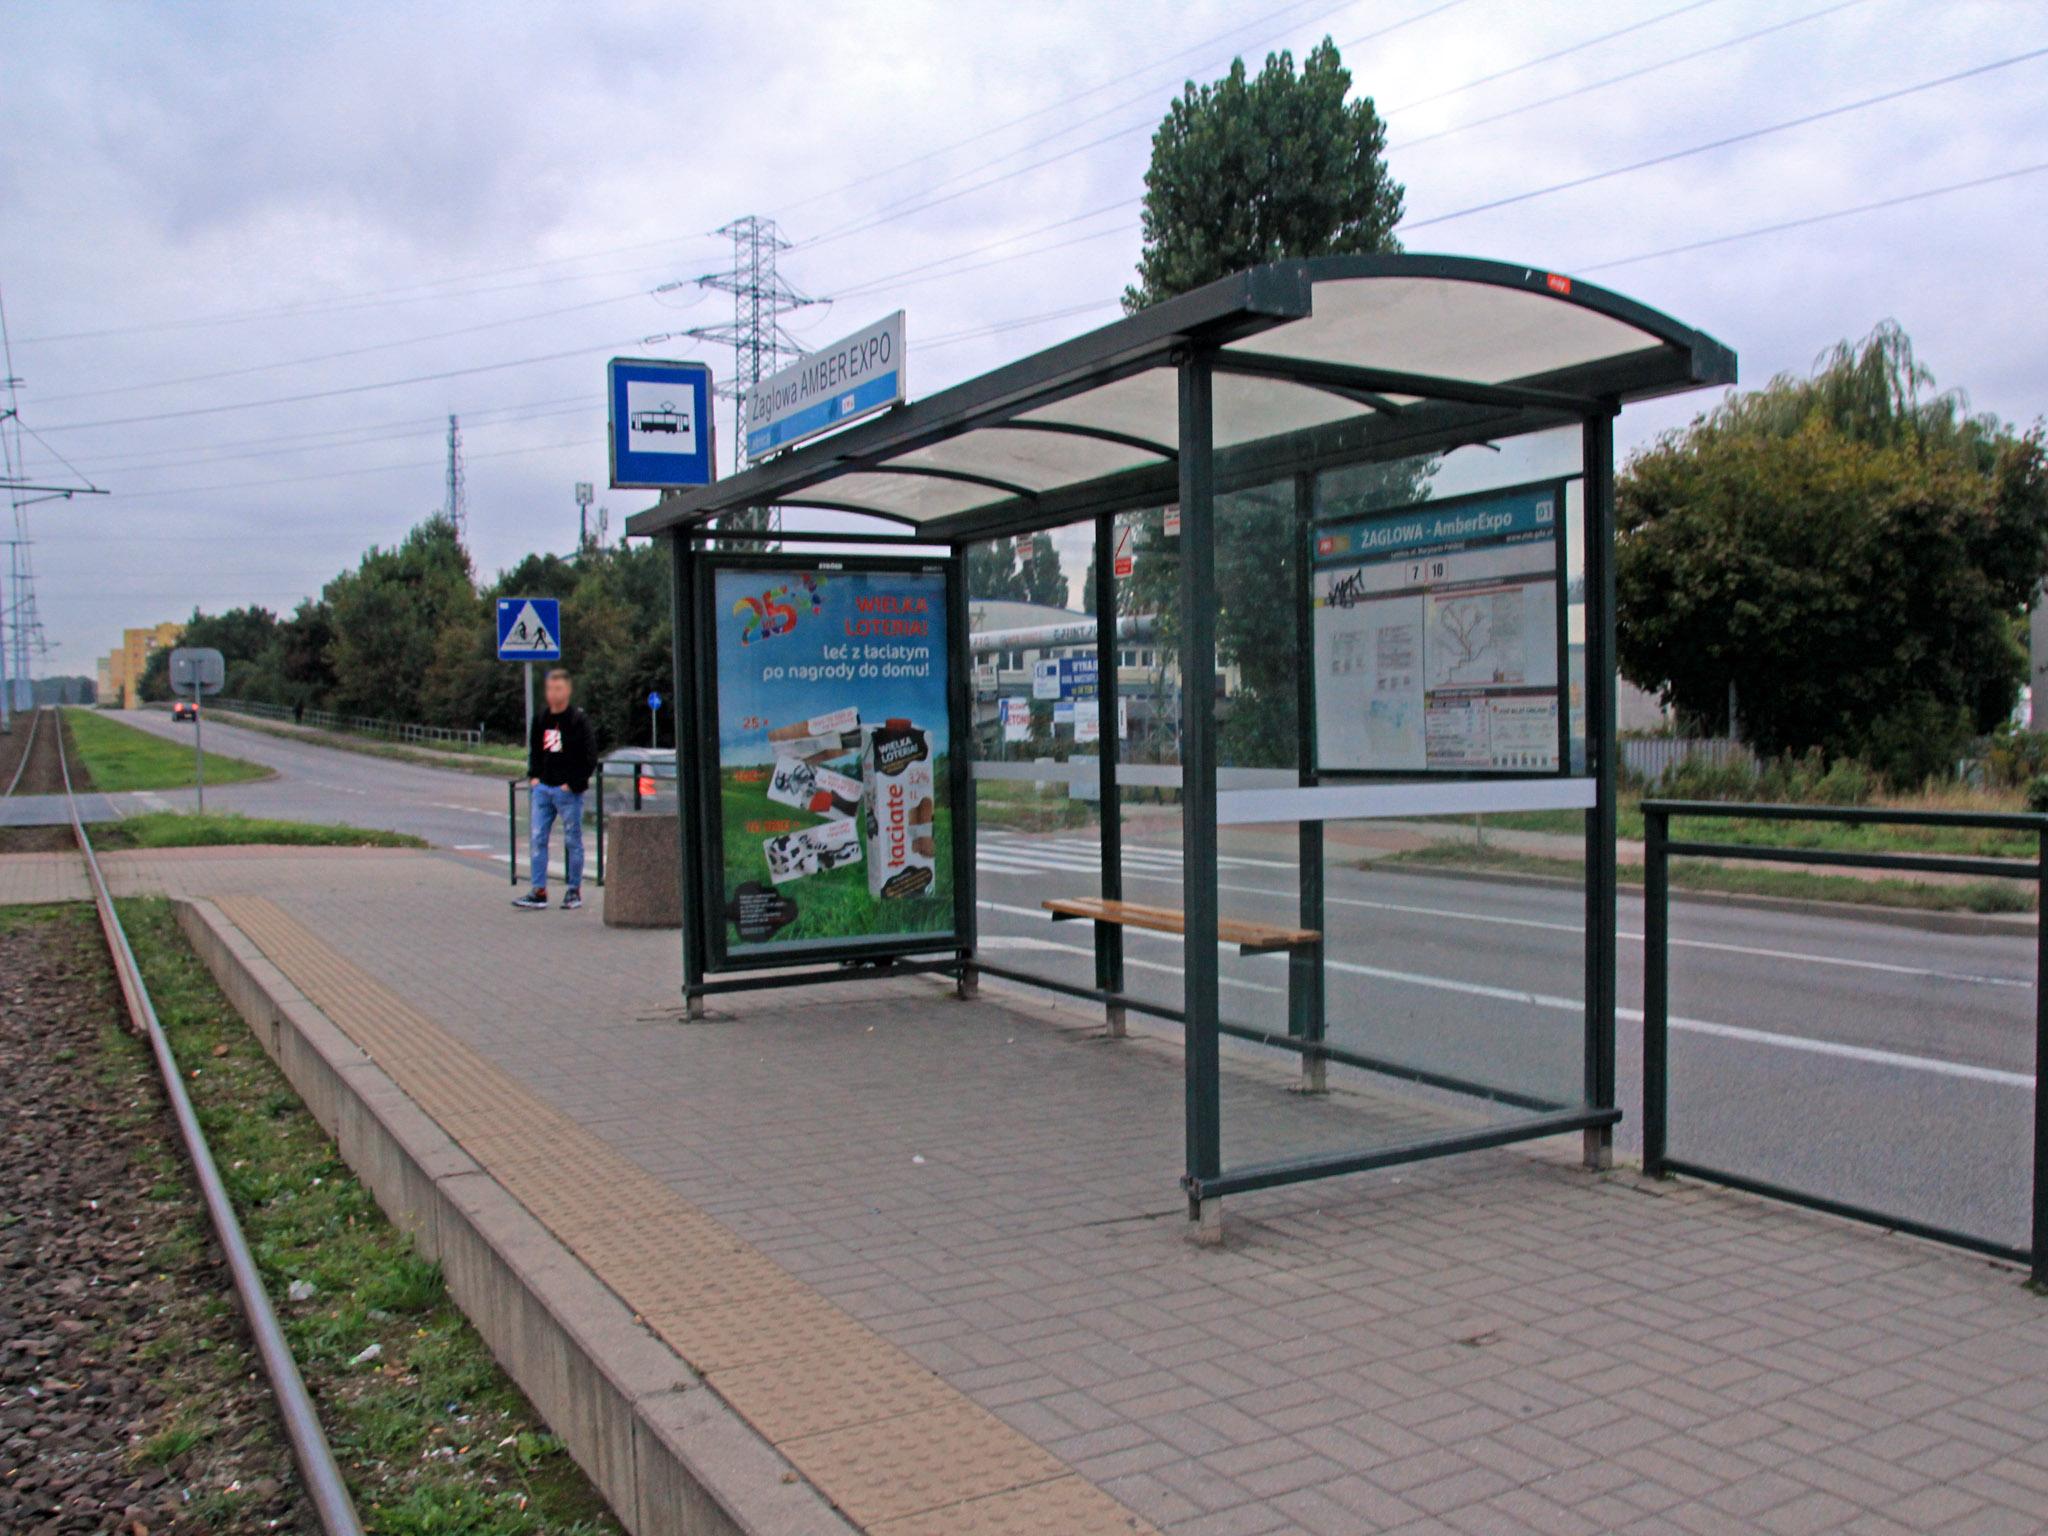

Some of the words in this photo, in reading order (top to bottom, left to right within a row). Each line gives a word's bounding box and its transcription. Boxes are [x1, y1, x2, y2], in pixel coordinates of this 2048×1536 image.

[1433, 511, 1512, 538] AmberExpo
[1412, 566, 1419, 580] 7
[1431, 562, 1443, 578] 10
[856, 596, 929, 613] WIELKA
[845, 619, 929, 637] LOTERIA!
[824, 644, 848, 660] leć
[852, 649, 861, 659] z
[864, 644, 930, 661] łaciatym
[763, 667, 784, 682] po
[789, 663, 855, 681] nagrody
[859, 663, 878, 677] do
[882, 663, 930, 677] domu!
[879, 736, 913, 754] WIELKA
[886, 783, 905, 868] łaciate
